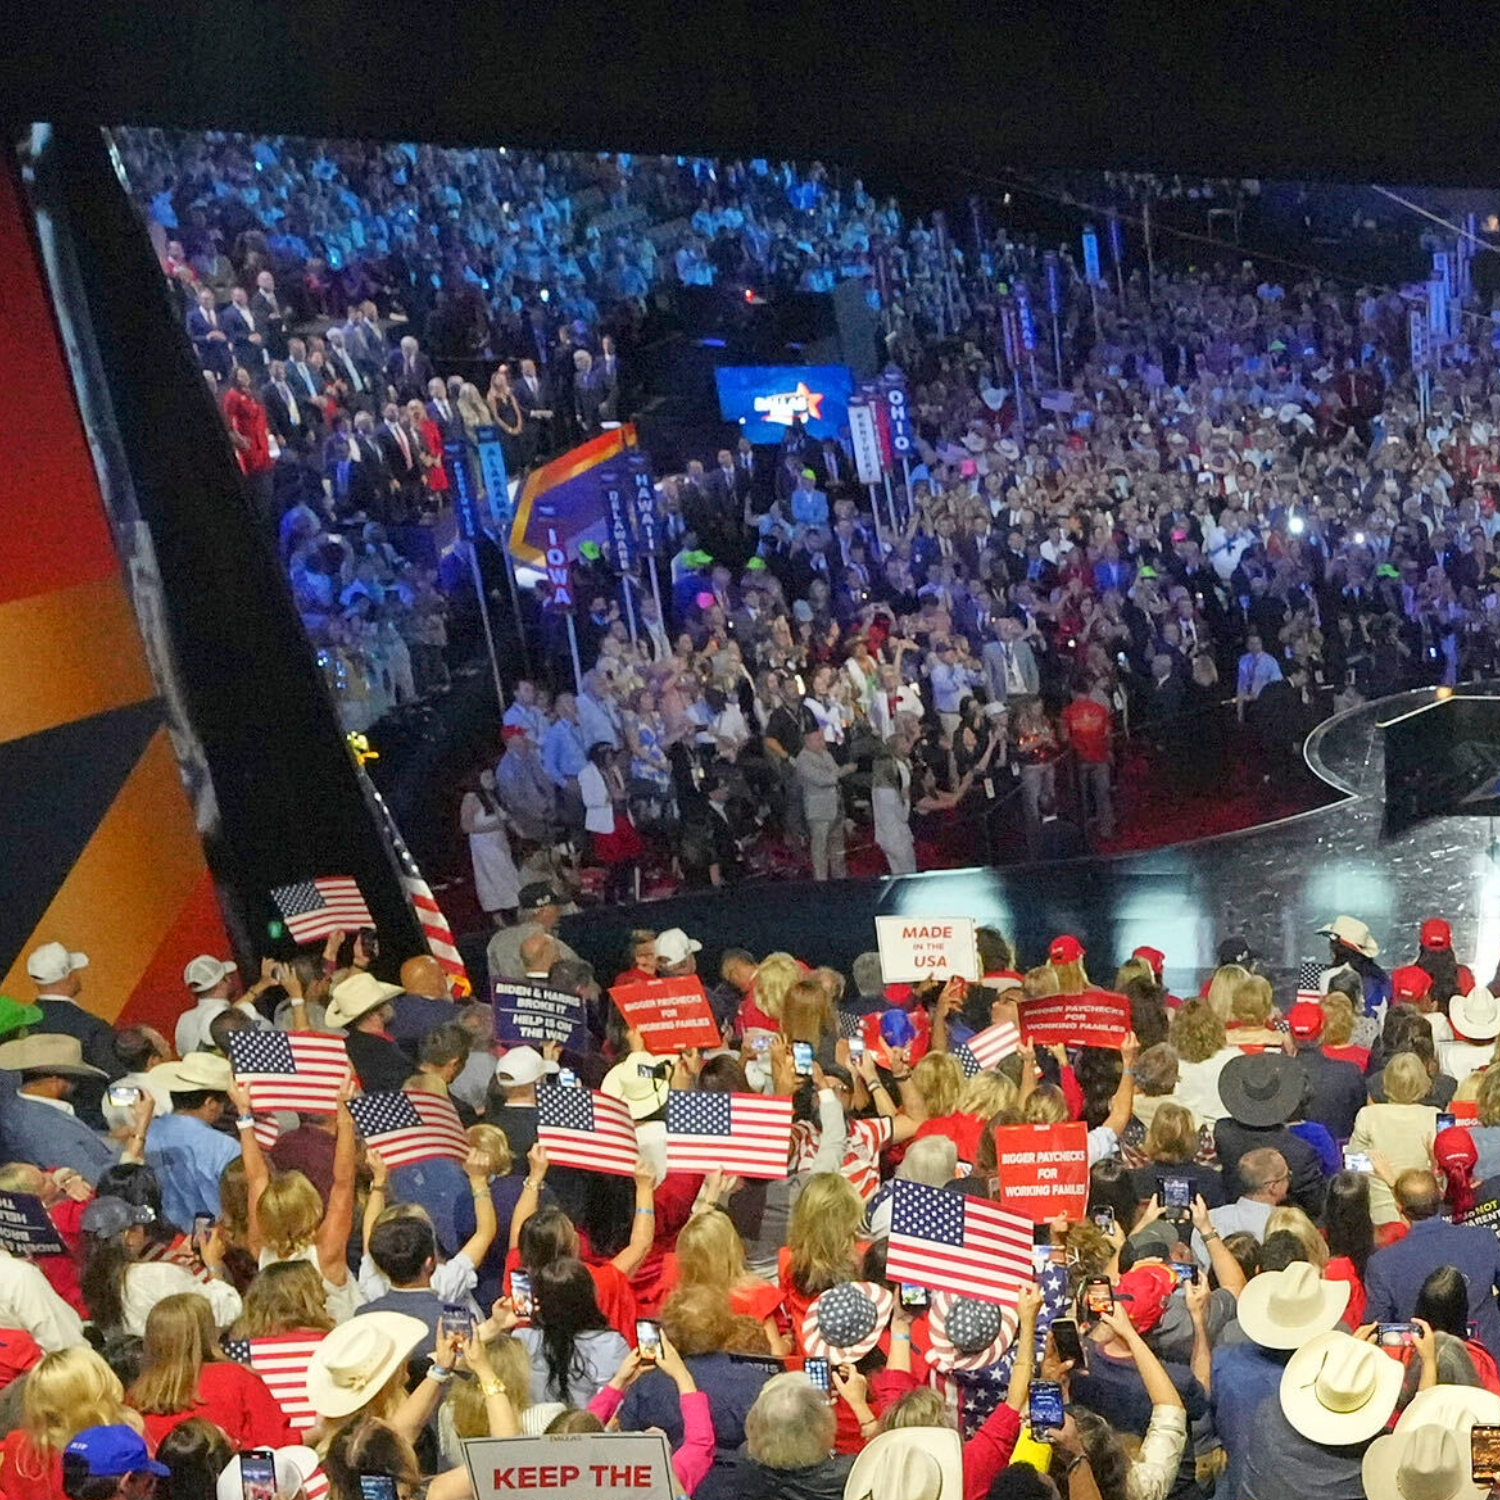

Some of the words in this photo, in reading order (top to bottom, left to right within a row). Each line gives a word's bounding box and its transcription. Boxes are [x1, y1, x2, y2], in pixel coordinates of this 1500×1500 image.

[888, 390, 909, 450] OHIO
[635, 474, 655, 550] HAWAII
[609, 490, 629, 570] DELAWARE
[548, 528, 572, 604] IOWA
[902, 926, 953, 938] MADE
[913, 943, 923, 951] IN
[926, 943, 944, 951] THE
[914, 955, 948, 968] USA
[496, 983, 532, 997] BIDEN
[543, 989, 580, 1008] HARRIS
[516, 997, 555, 1012] BROKE
[556, 1003, 567, 1015] IT
[1065, 1004, 1125, 1017] PAYCHECKS
[661, 1008, 678, 1019] FOR
[1065, 1013, 1086, 1021] FOR
[513, 1013, 543, 1026] HELP
[545, 1018, 555, 1028] IS
[556, 1021, 573, 1032] ON
[676, 1017, 711, 1029] FAMILIES
[1026, 1022, 1077, 1031] WORKING
[1079, 1022, 1126, 1033] FAMILIES
[520, 1027, 544, 1039] THE
[545, 1029, 569, 1043] WAY
[1001, 1152, 1036, 1165] BIGGER
[1036, 1150, 1085, 1163] PAYCHECKS
[1037, 1168, 1058, 1180] FOR
[1005, 1184, 1050, 1197] WORKING
[1475, 1200, 1498, 1214] NOT
[493, 1465, 581, 1490] KEEP
[589, 1465, 653, 1488] THE
